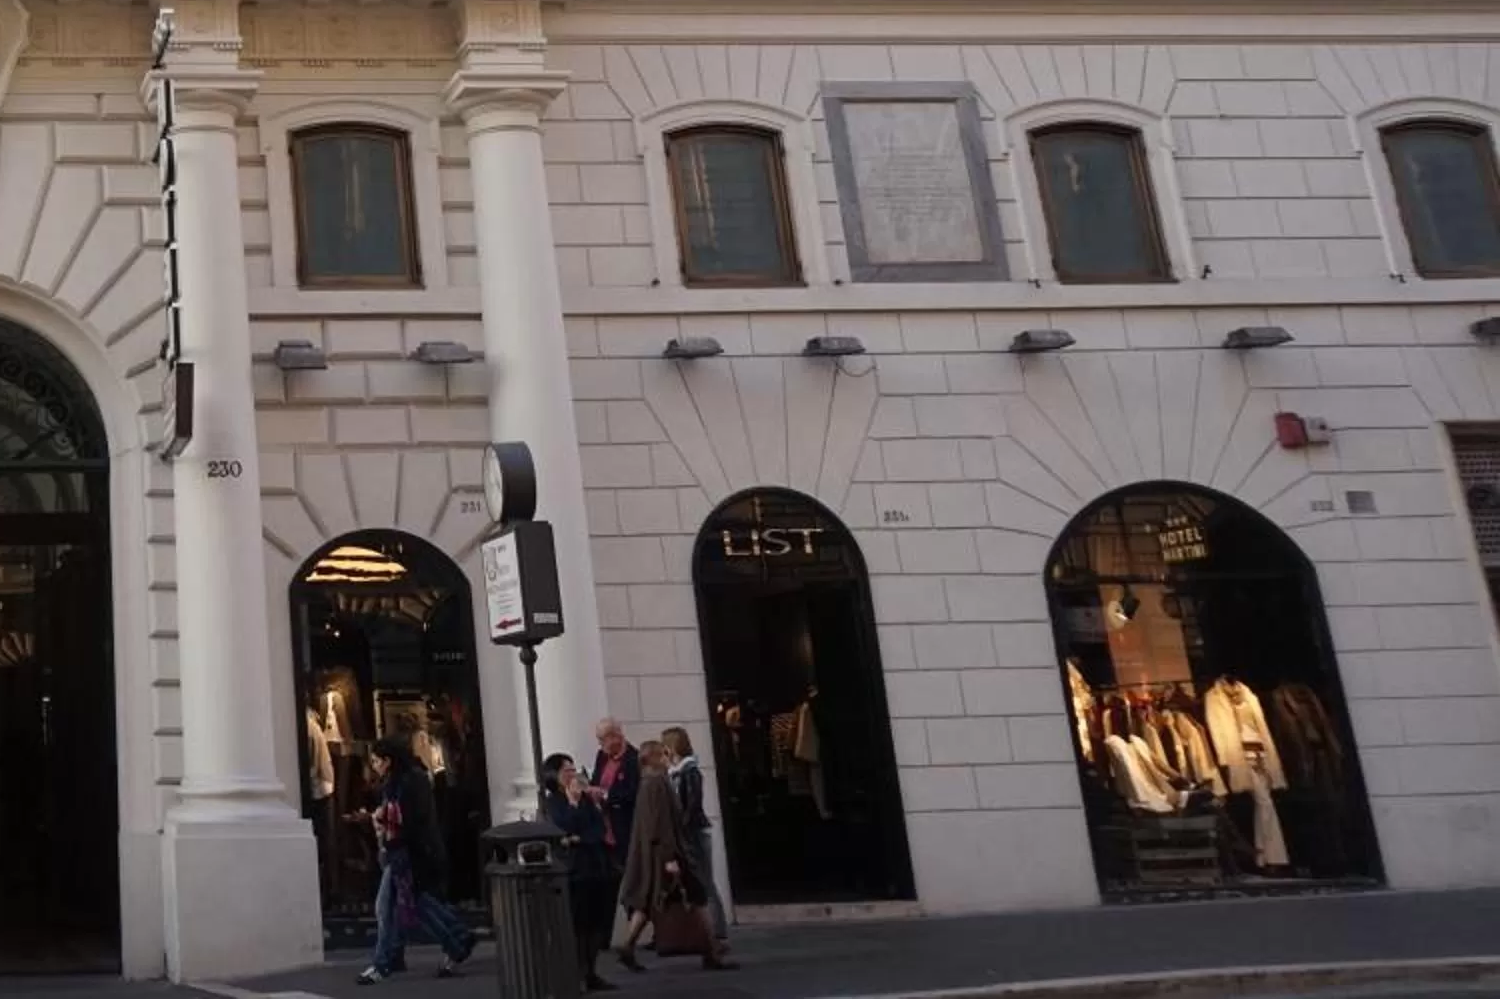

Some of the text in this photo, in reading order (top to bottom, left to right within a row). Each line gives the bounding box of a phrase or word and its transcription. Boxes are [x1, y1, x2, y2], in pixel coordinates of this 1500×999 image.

[207, 460, 243, 479] 230
[460, 501, 481, 514] 231
[722, 528, 824, 556] LIST
[1159, 526, 1203, 548] HOTEL
